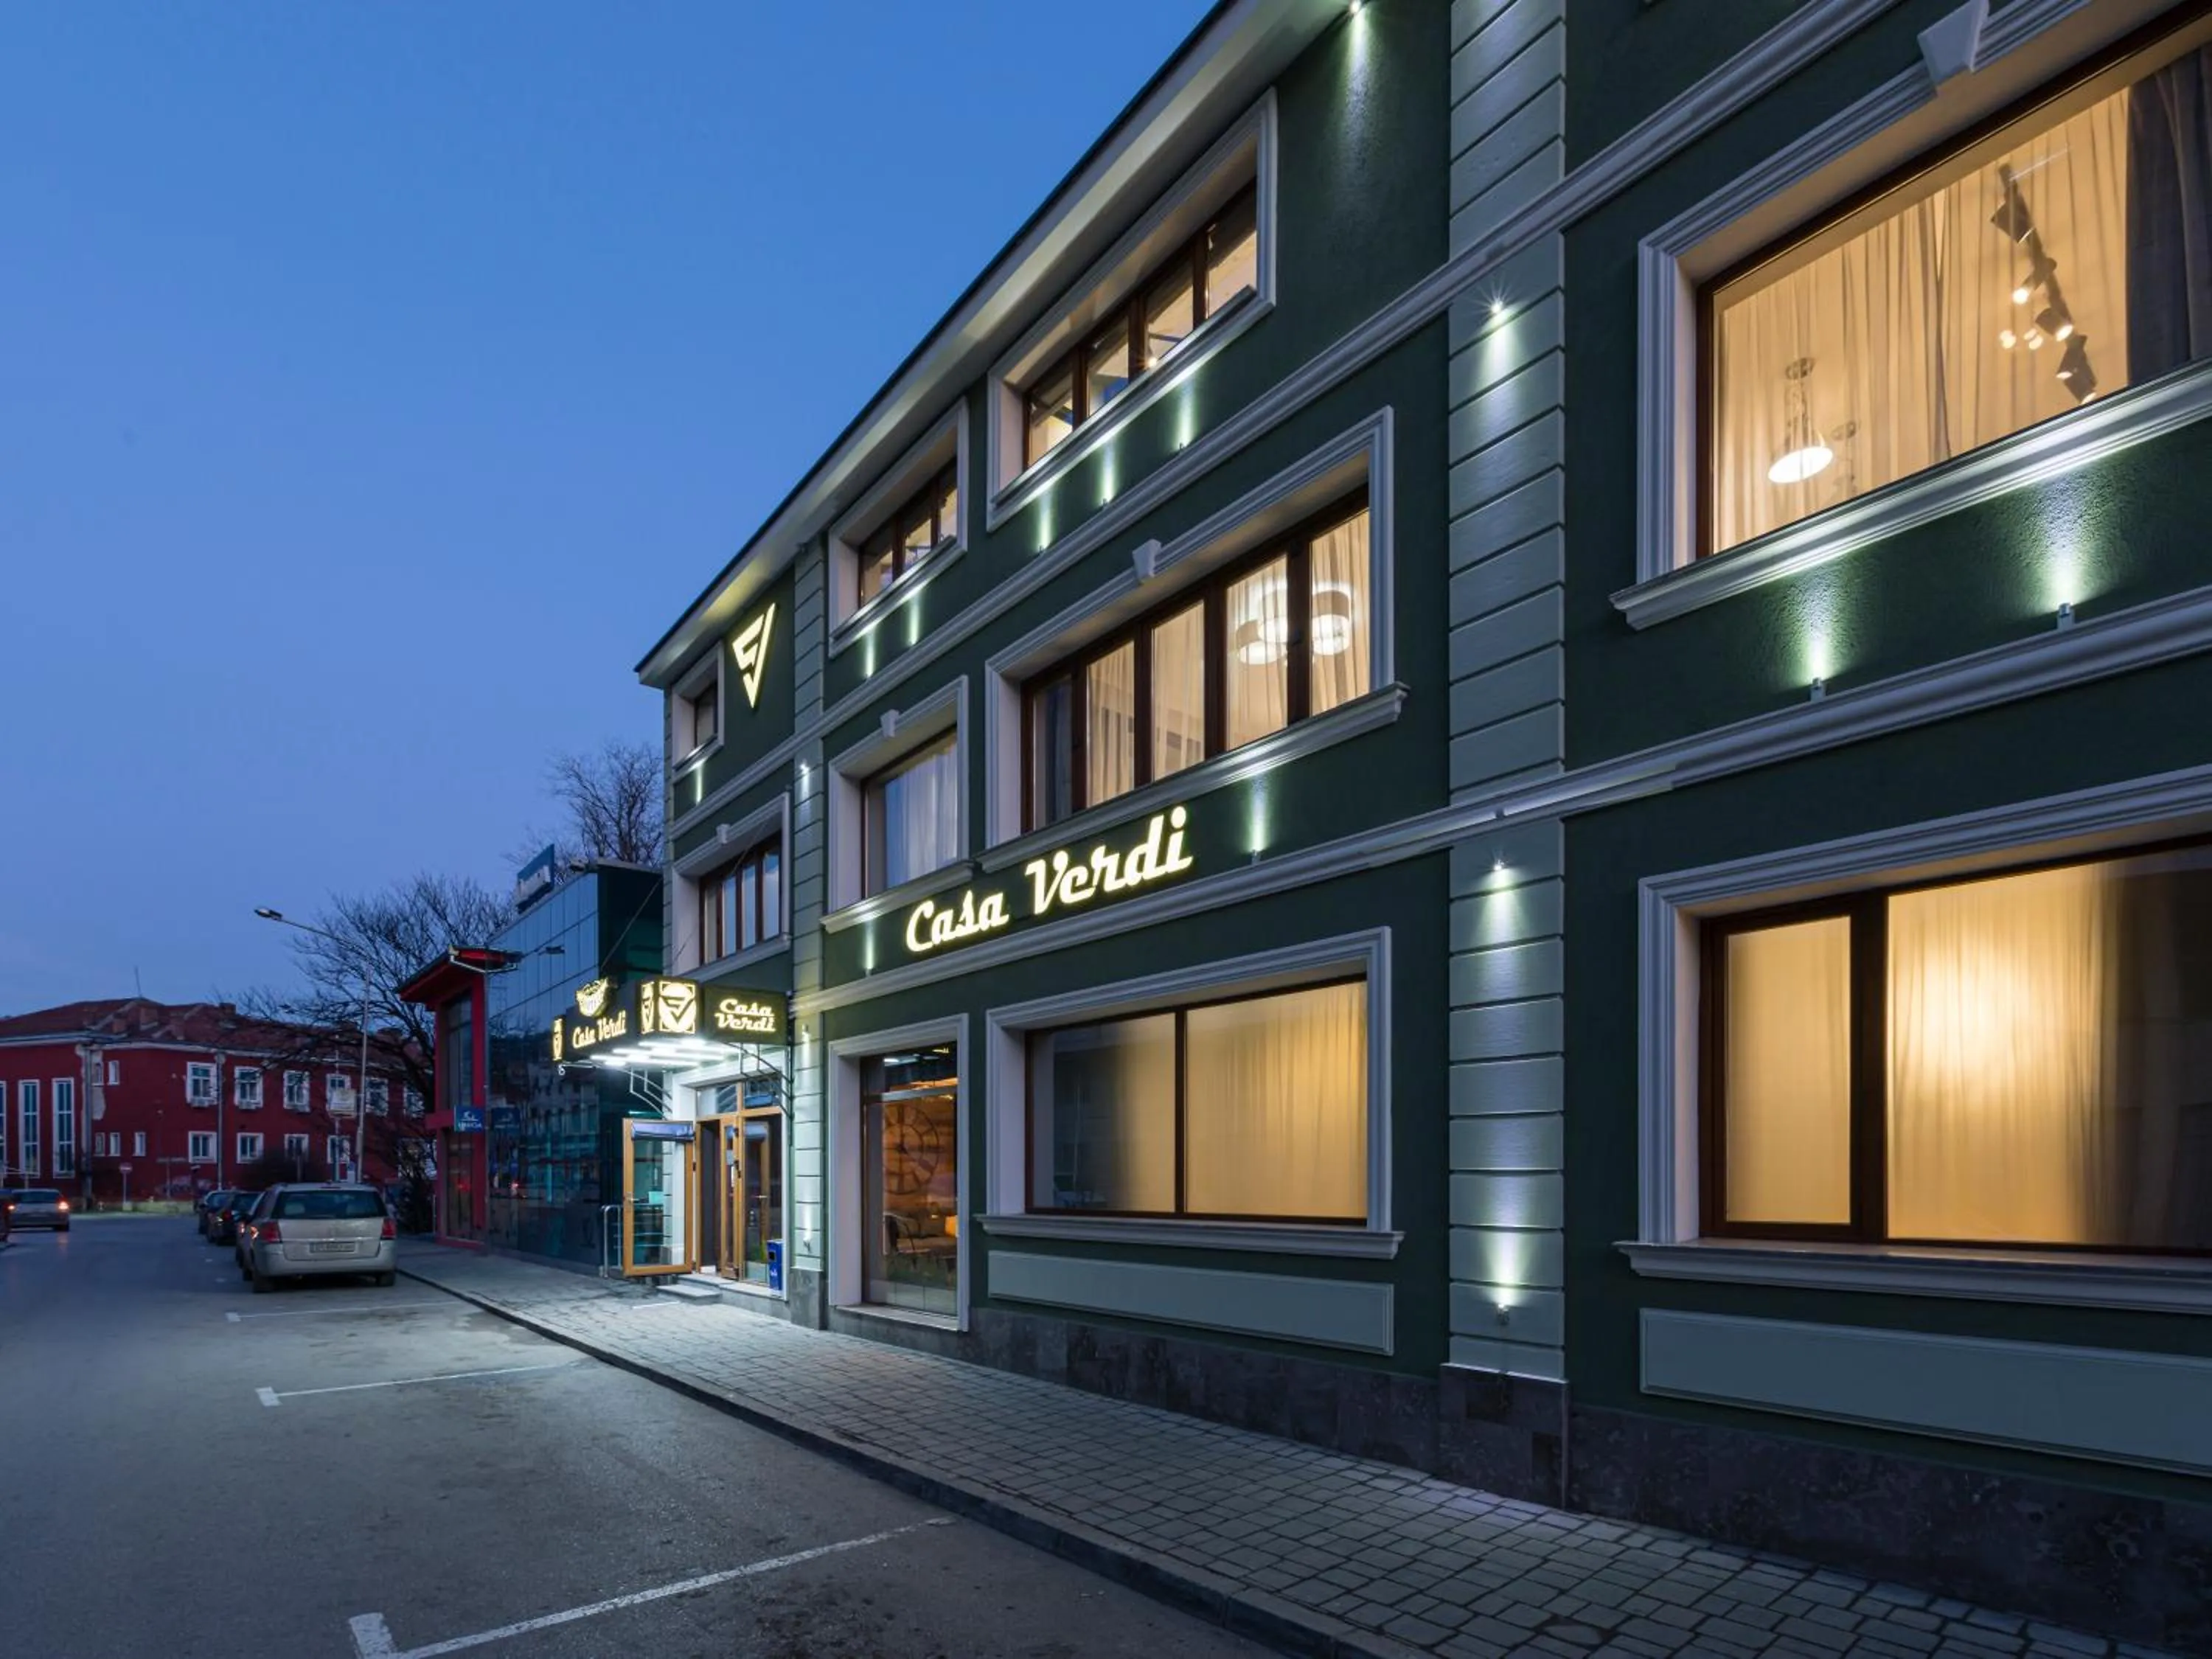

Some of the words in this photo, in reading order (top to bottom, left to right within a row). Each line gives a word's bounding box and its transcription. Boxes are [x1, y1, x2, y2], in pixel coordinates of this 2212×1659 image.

[905, 890, 1009, 952] Casa
[1025, 806, 1193, 915] Verdi
[714, 1012, 776, 1032] Verdi
[720, 998, 775, 1017] Casa
[572, 1026, 596, 1048] Casa
[597, 1009, 627, 1041] Verdi
